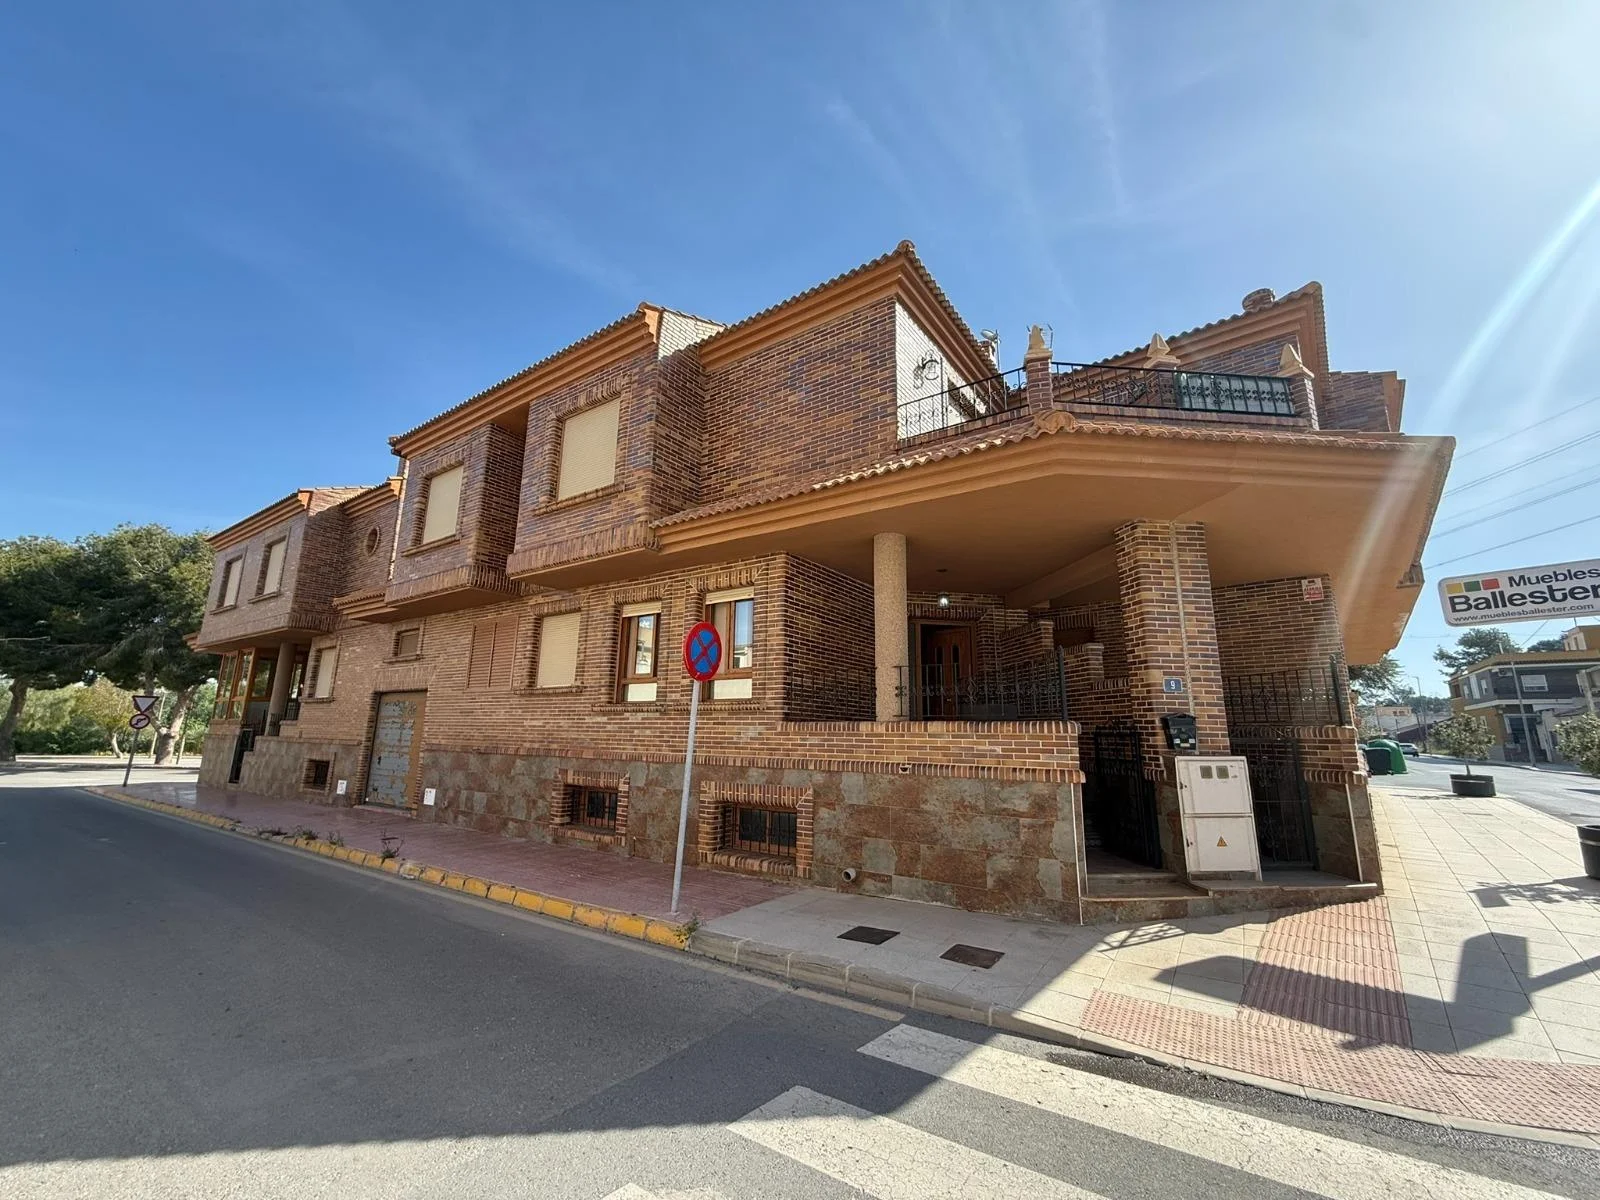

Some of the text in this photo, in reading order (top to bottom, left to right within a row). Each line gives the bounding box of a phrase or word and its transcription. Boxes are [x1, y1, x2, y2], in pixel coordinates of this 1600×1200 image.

[1508, 568, 1600, 587] Muebles
[1448, 584, 1600, 613] Ballester
[1453, 604, 1594, 622] www.mueblesballester.com
